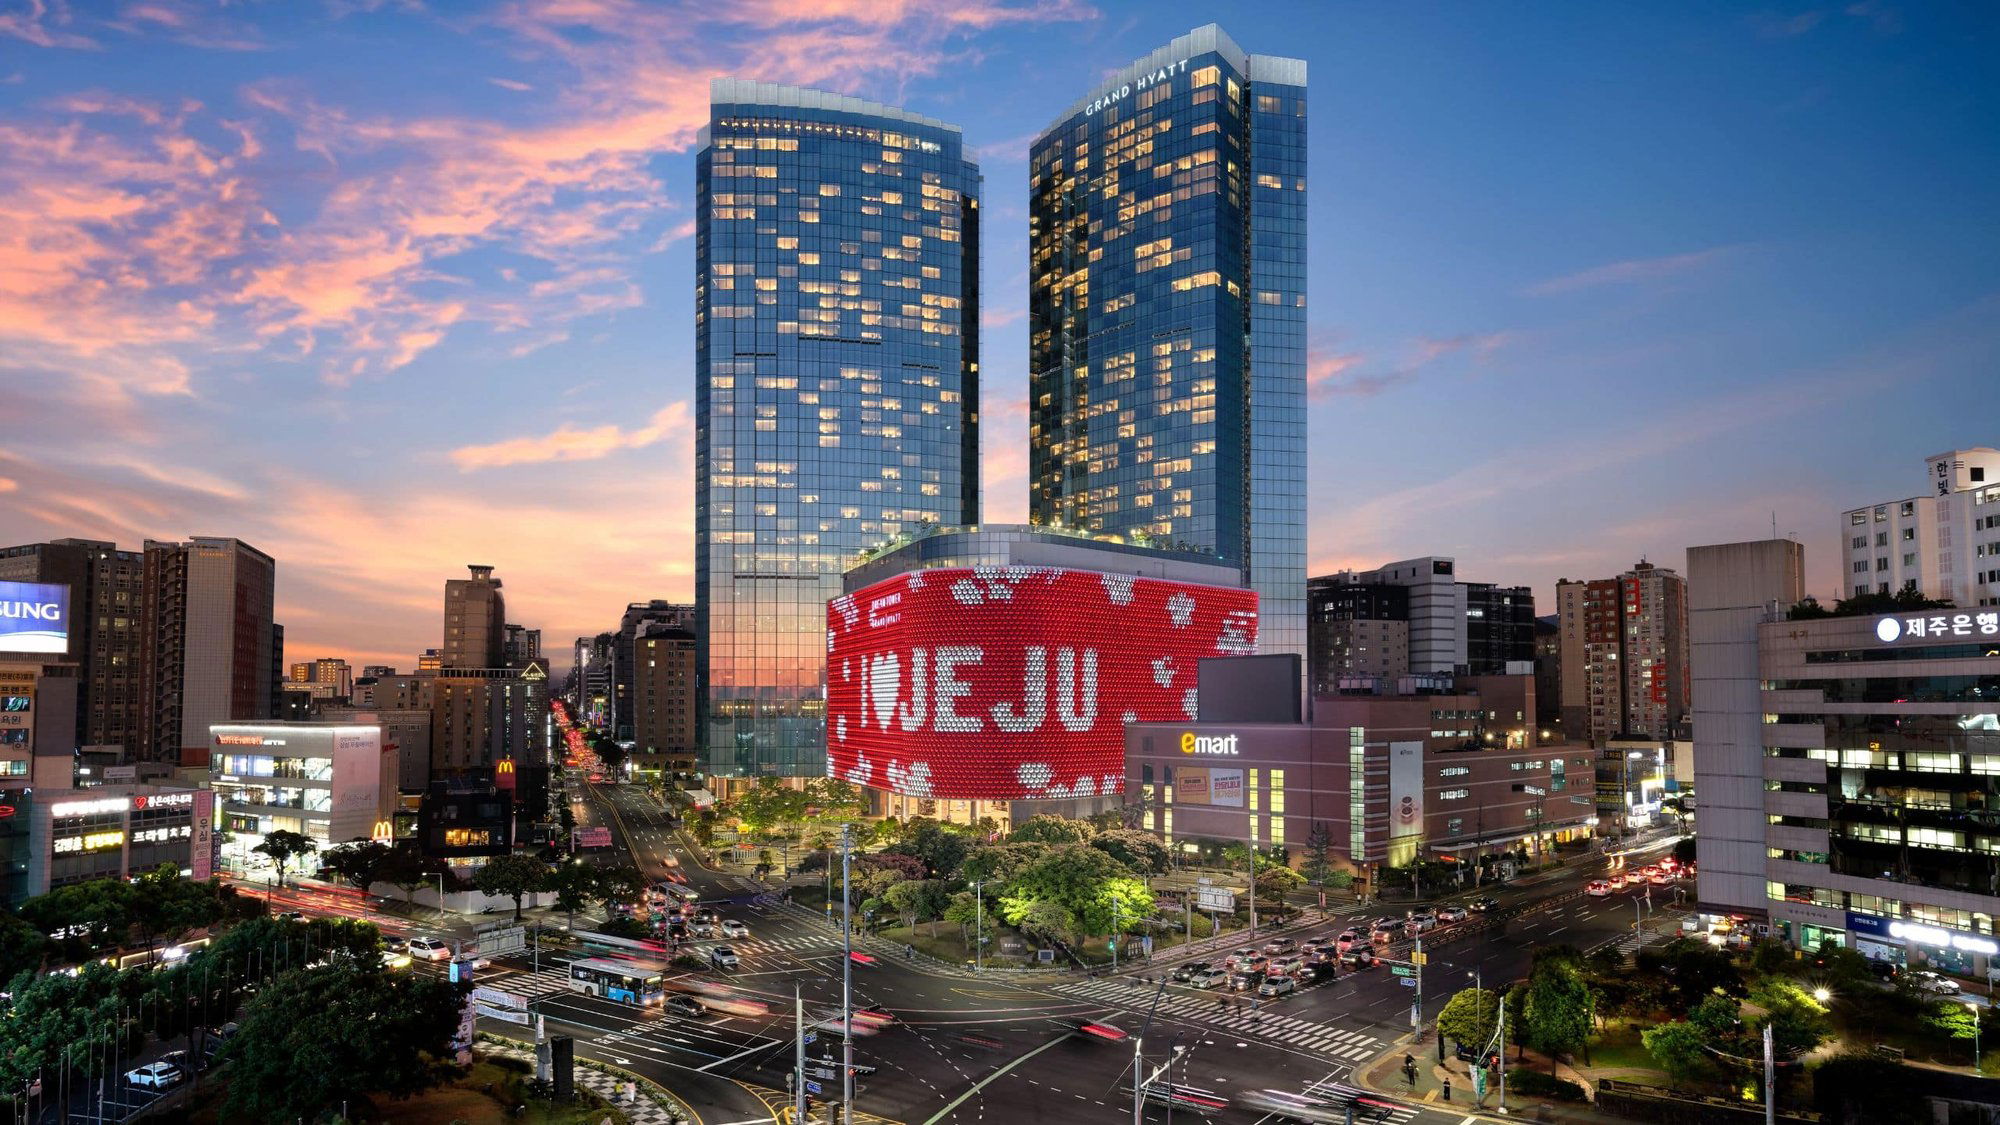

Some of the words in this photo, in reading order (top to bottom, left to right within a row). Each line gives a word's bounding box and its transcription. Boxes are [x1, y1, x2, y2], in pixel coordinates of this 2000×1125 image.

[1085, 85, 1130, 116] GRAND
[1137, 59, 1188, 90] HYATT
[1936, 460, 1950, 497] 한빛
[0, 601, 60, 620] UNG
[1905, 612, 1999, 637] 제주은행
[899, 644, 1098, 732] JEJU
[1181, 732, 1239, 755] emart
